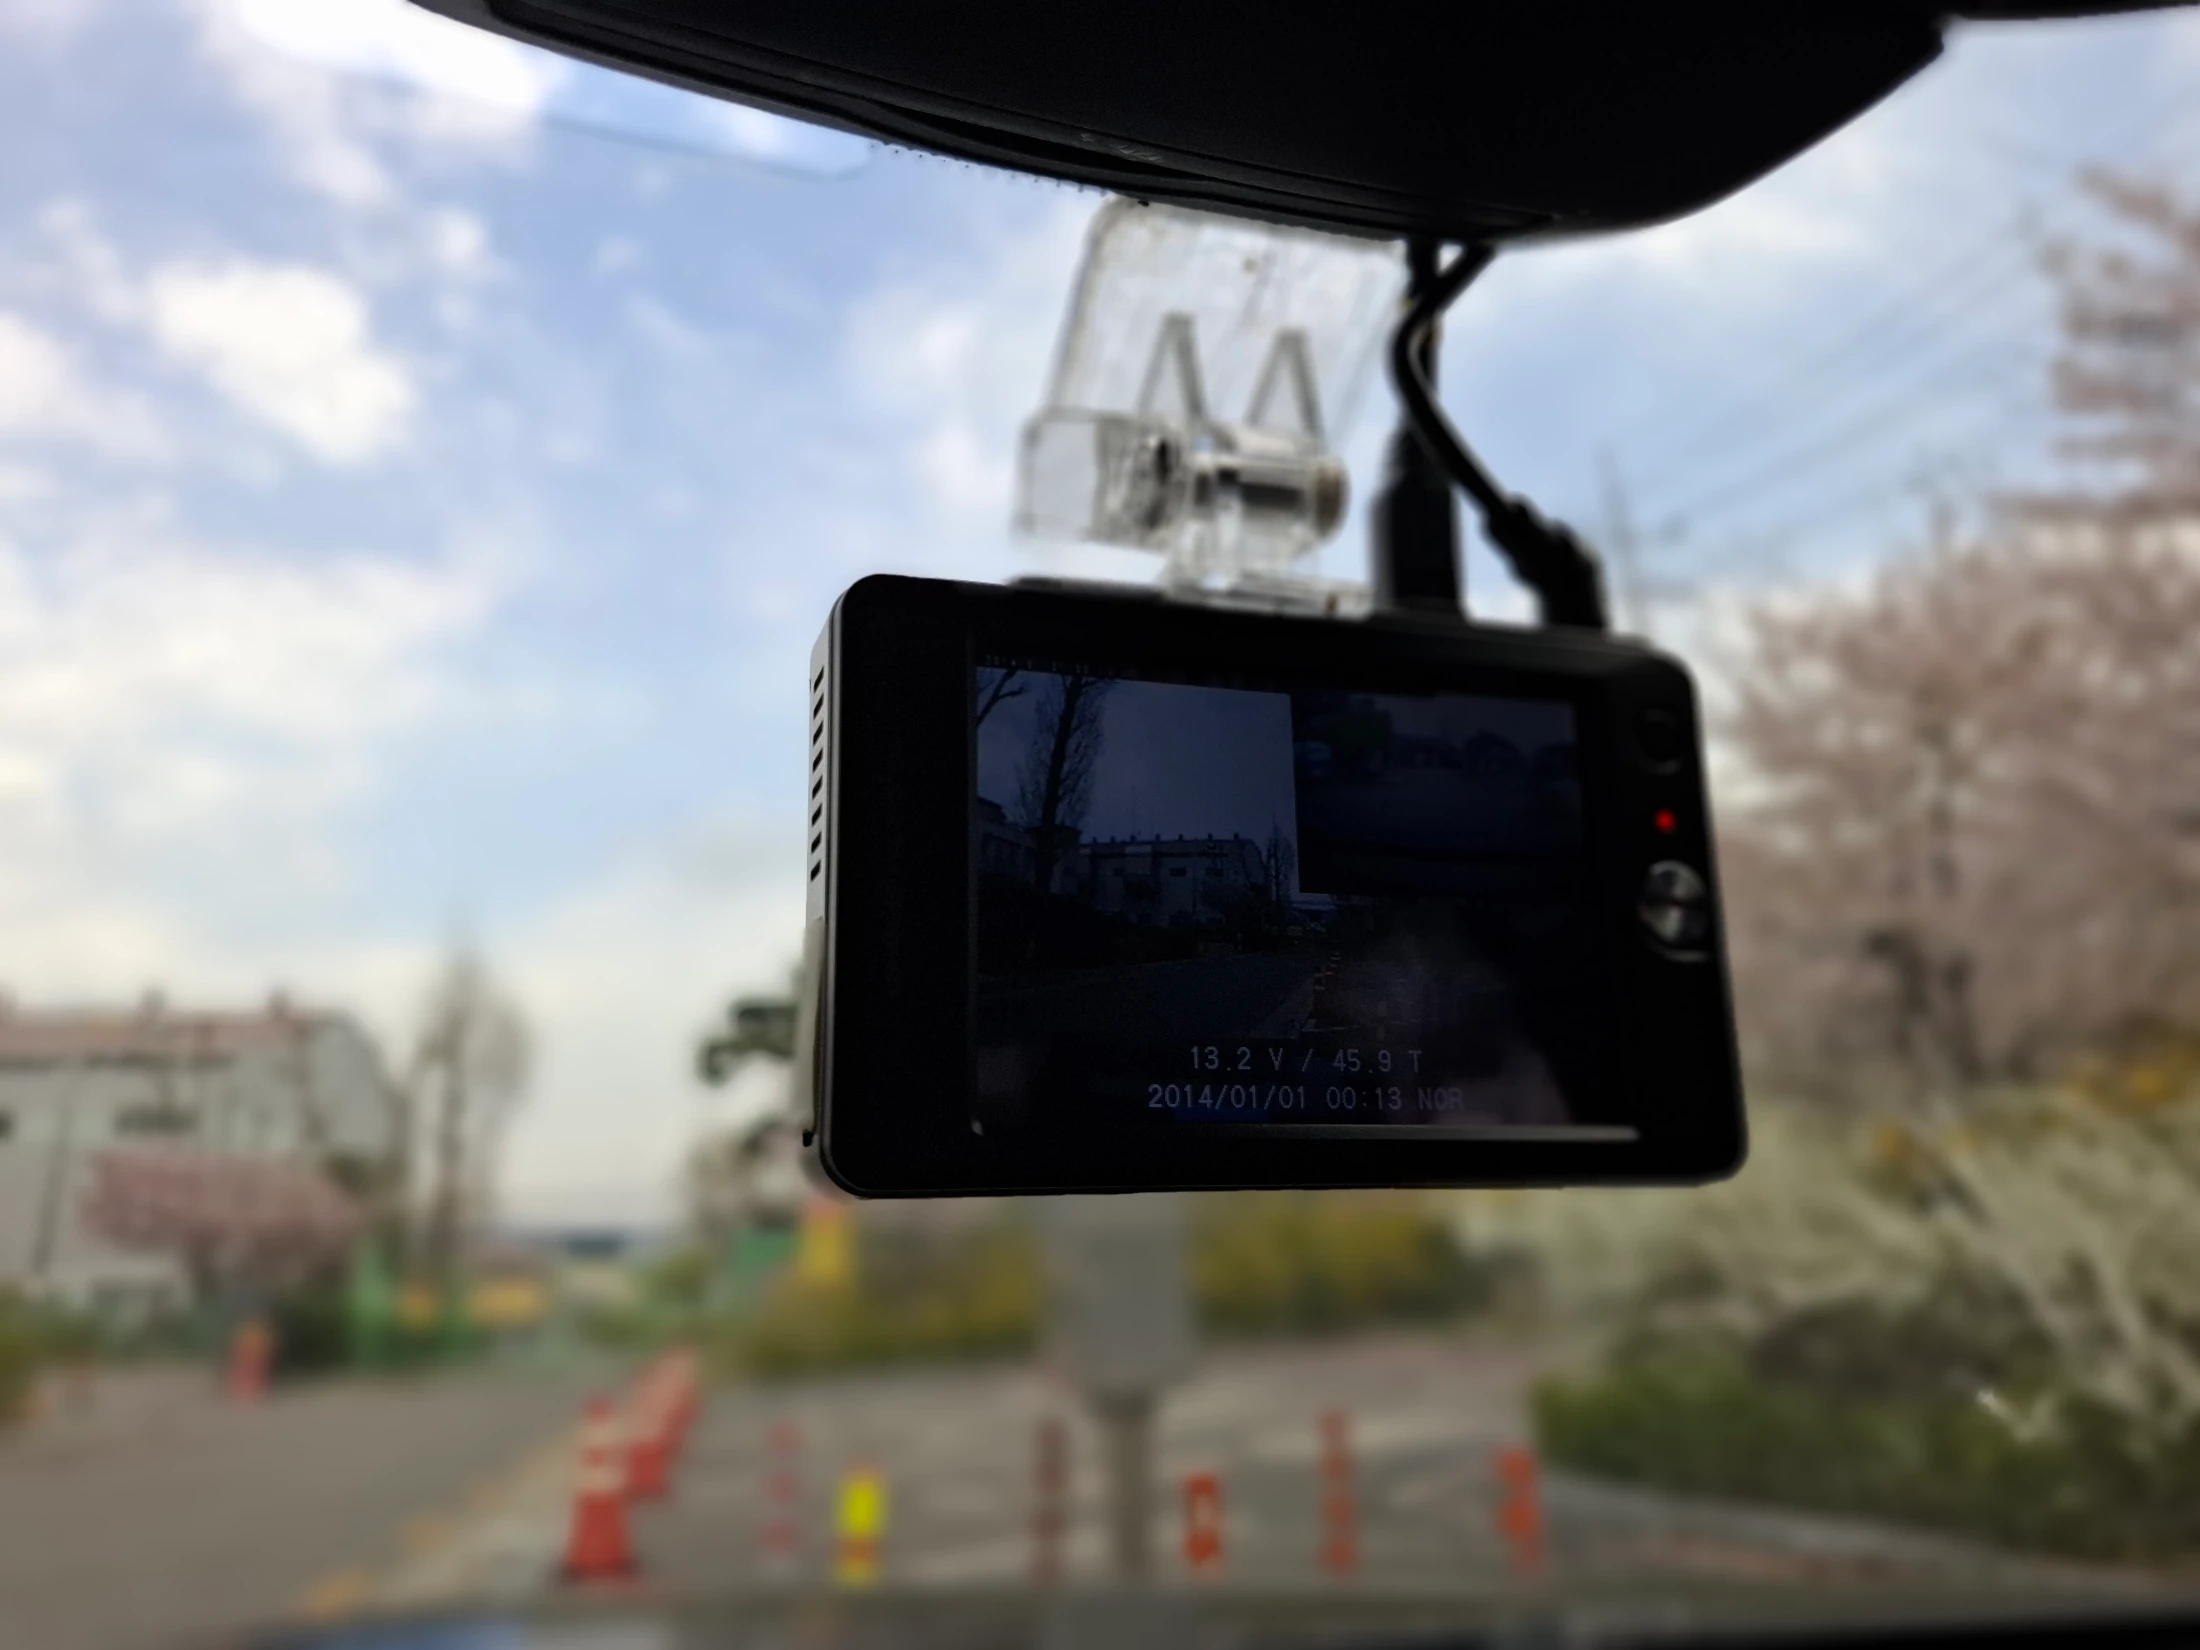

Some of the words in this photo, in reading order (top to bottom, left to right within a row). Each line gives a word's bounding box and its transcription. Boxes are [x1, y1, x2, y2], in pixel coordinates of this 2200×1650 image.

[1190, 1045, 1251, 1071] 13.2
[1268, 1047, 1284, 1071] V
[1301, 1048, 1314, 1073] /
[1332, 1049, 1392, 1074] 45.9
[1408, 1050, 1422, 1073] T
[1148, 1083, 1305, 1110] 2014/01/01
[1326, 1085, 1401, 1111] 00:13
[1417, 1087, 1465, 1112] NOR
